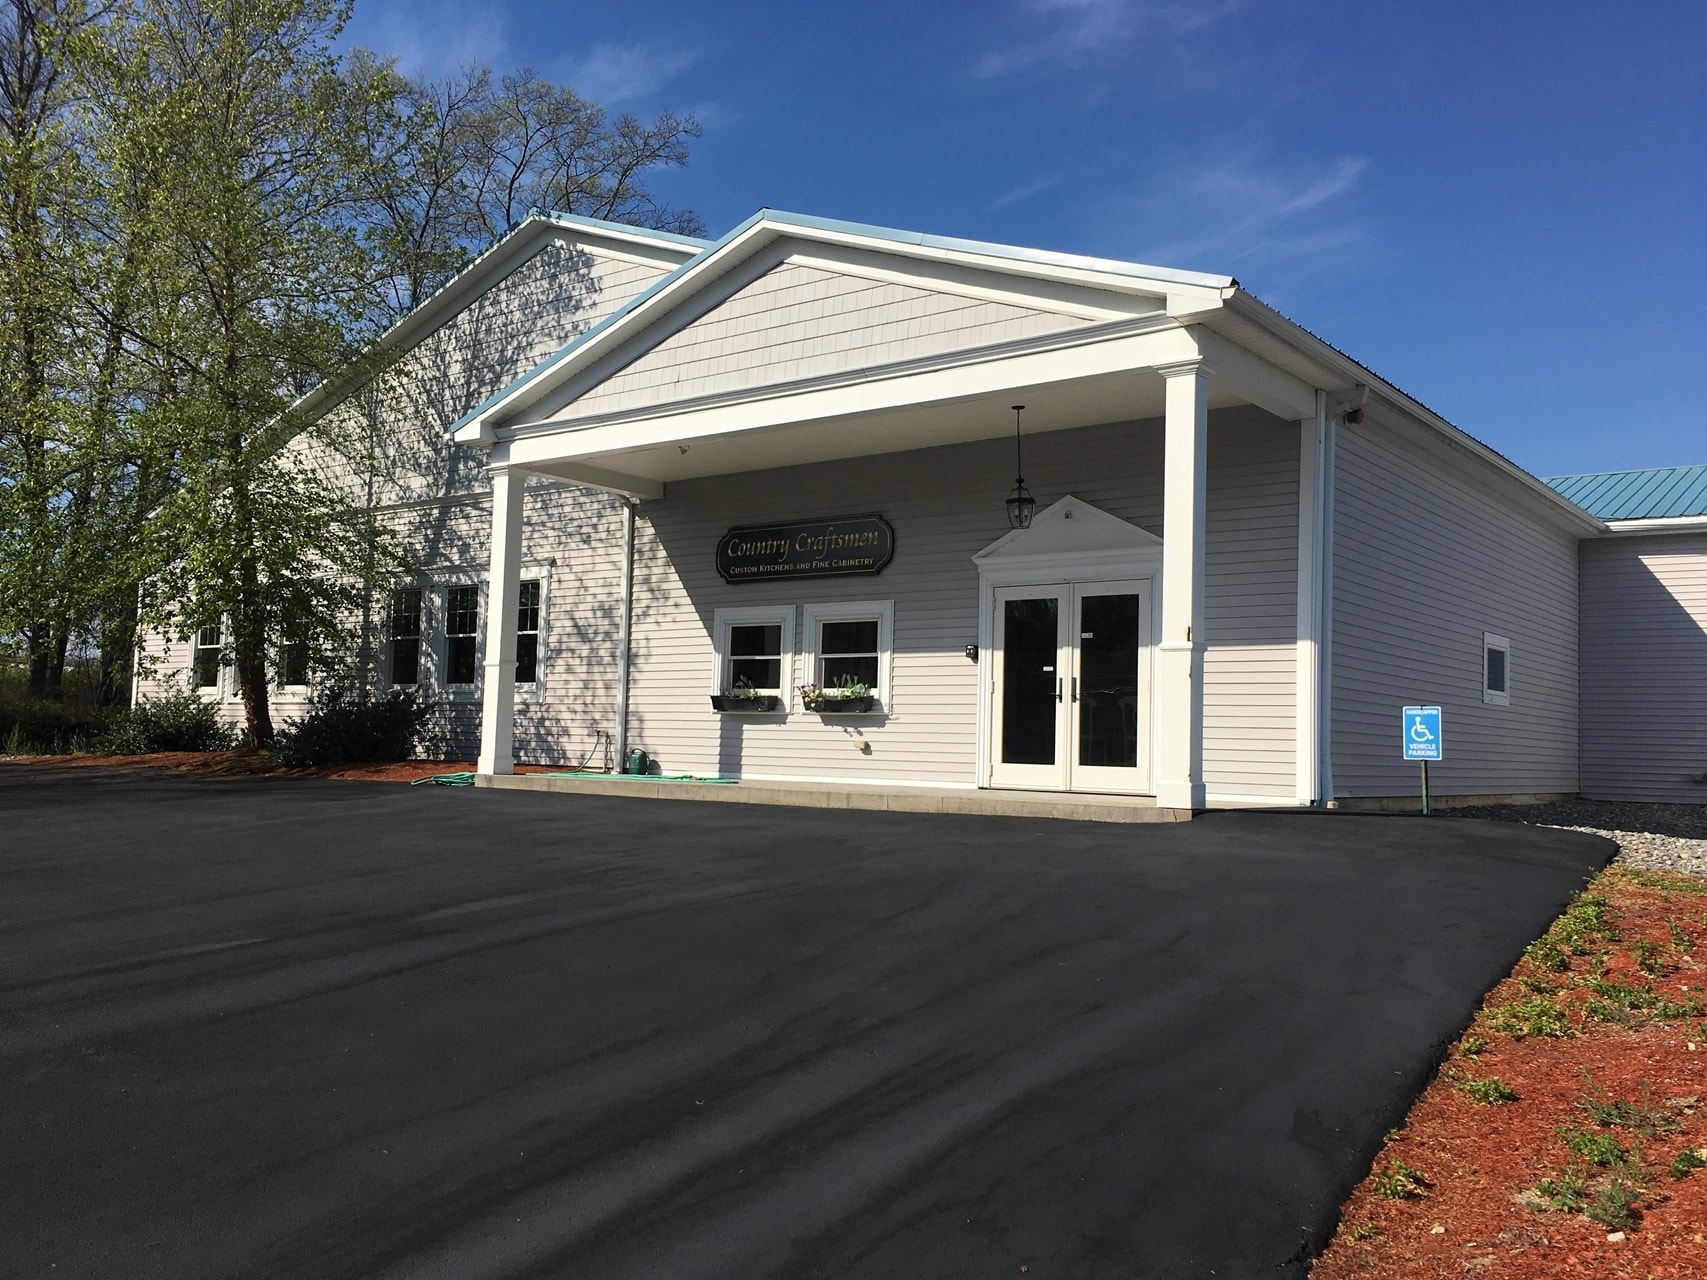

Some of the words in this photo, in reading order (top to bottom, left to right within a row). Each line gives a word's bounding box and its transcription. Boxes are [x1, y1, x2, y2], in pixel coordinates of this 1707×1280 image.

[727, 538, 790, 562] Country
[795, 526, 879, 560] Craftsmen
[729, 565, 758, 574] CUSTOM
[759, 563, 794, 573] KITCHENS
[796, 562, 811, 570] AND
[812, 560, 830, 569] FINE
[832, 557, 874, 568] CABINETRY
